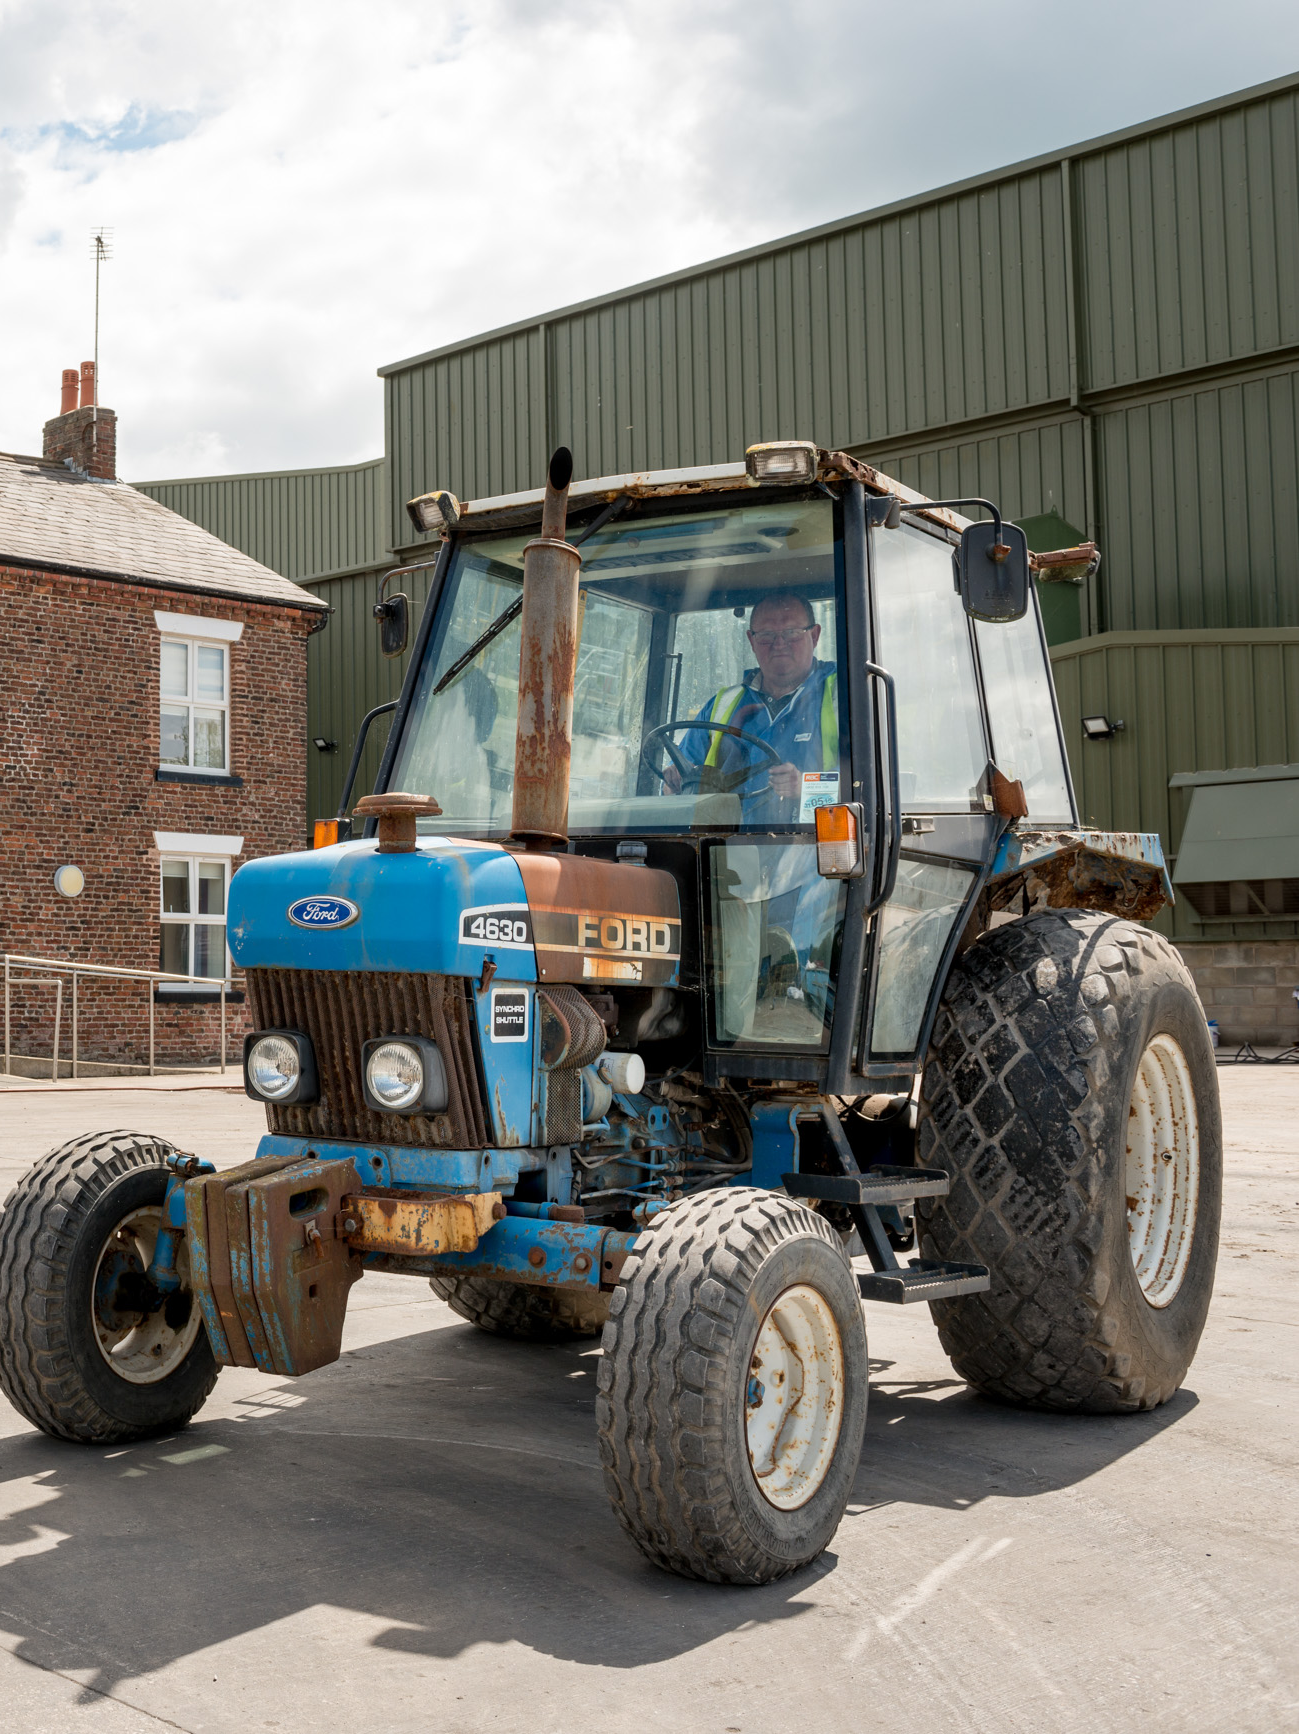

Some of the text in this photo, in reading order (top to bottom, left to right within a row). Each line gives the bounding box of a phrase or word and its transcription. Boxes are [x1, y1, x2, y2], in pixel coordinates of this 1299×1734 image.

[811, 797, 824, 807] 05
[302, 902, 340, 920] Ford
[470, 916, 527, 943] 4630
[578, 915, 671, 953] FORD
[495, 1005, 525, 1013] SYNCHRO
[496, 1016, 524, 1024] SHUTTLE
